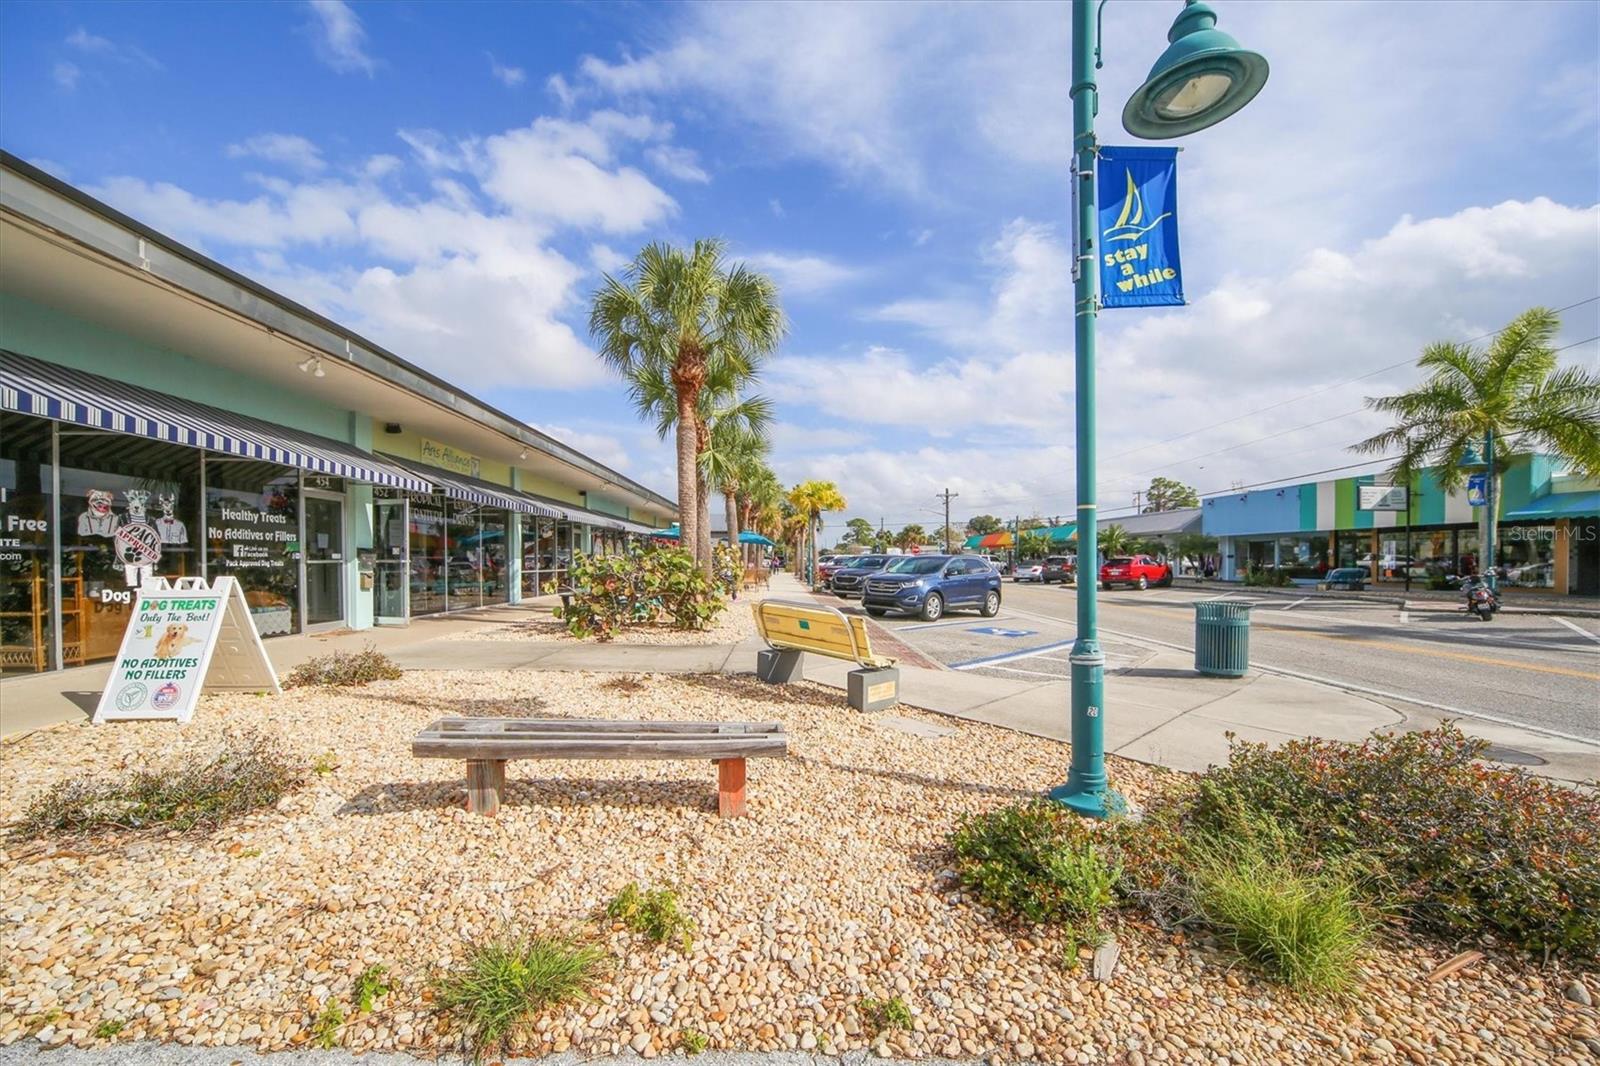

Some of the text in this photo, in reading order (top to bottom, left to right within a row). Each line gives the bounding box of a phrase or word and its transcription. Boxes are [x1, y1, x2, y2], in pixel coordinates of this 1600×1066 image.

[1104, 243, 1148, 267] stay
[1120, 263, 1135, 276] a
[1116, 267, 1177, 293] while
[8, 515, 47, 532] Free
[222, 508, 286, 524] Healthy Treats
[128, 526, 158, 552] PACK
[208, 527, 296, 542] No Additives or Fillers
[117, 530, 158, 560] APPROVED
[239, 560, 260, 568] Approved
[261, 560, 270, 568] Dog
[101, 589, 131, 604] Dog
[170, 600, 216, 610] TREATS
[140, 612, 211, 623] Only The Best!
[121, 658, 198, 668] NO ADDITIVES
[125, 669, 187, 680] NO FILLERS
